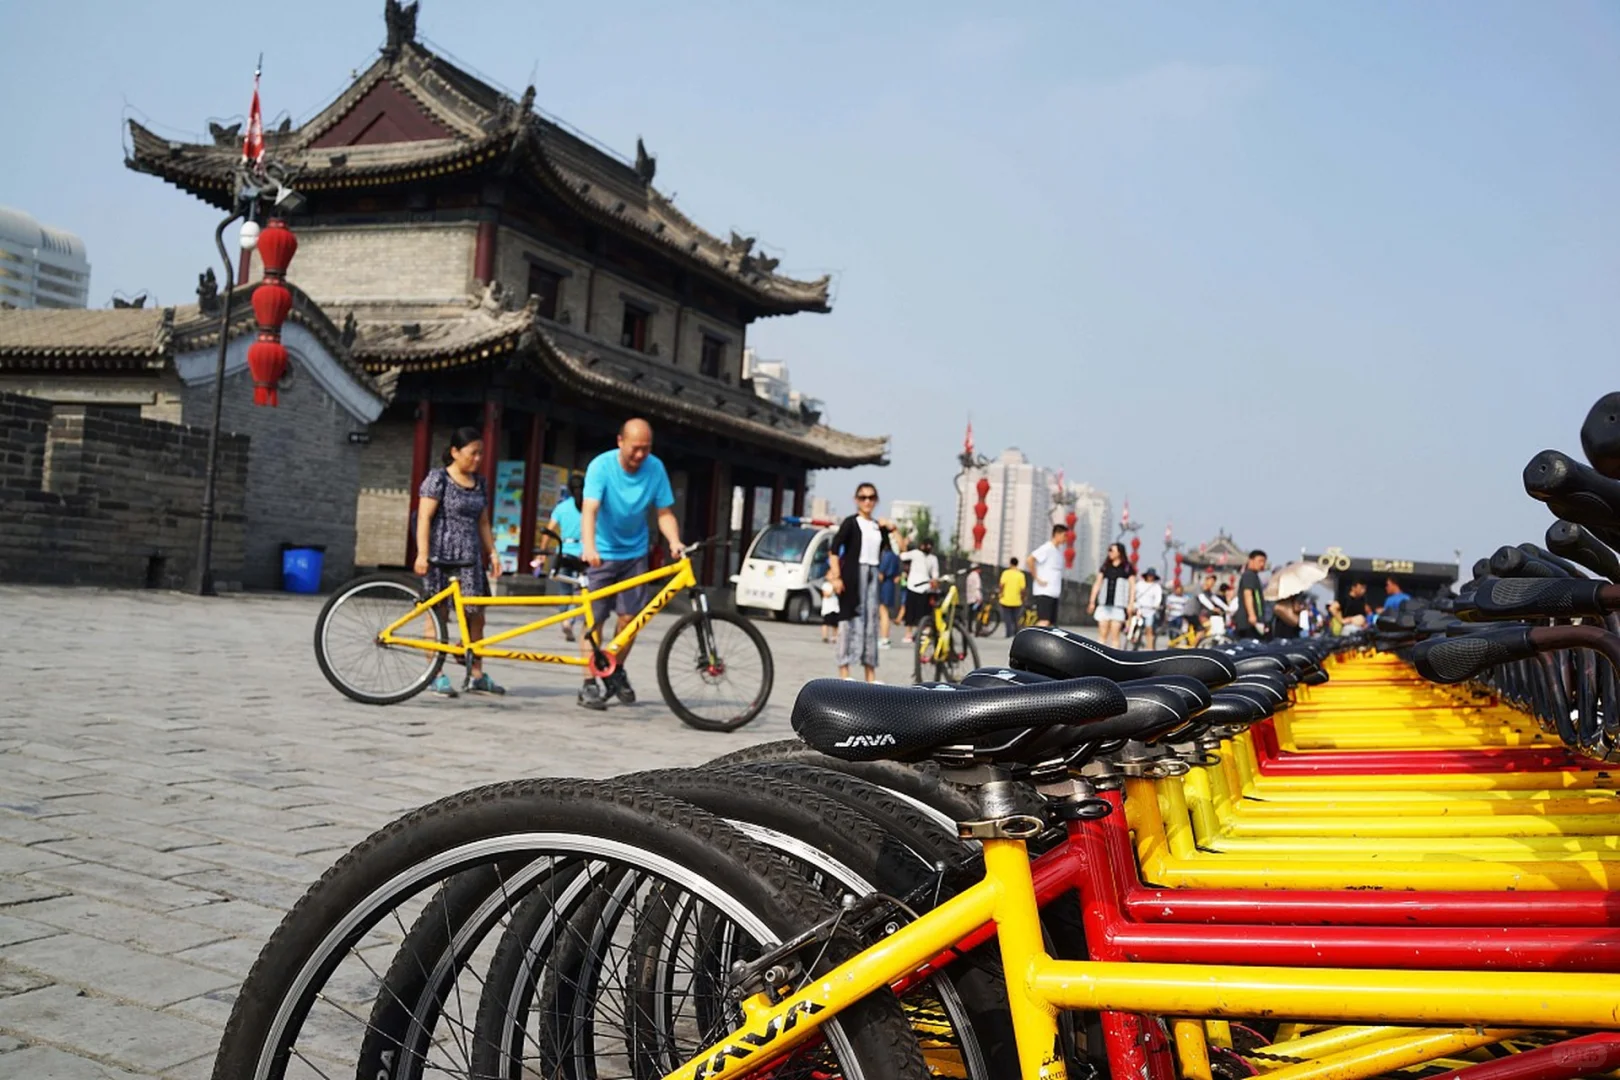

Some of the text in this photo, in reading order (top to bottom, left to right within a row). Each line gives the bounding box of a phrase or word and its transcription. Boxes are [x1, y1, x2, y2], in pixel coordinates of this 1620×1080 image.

[629, 589, 677, 639] JAVA
[506, 651, 567, 664] JAVA
[834, 733, 896, 748] JAVA
